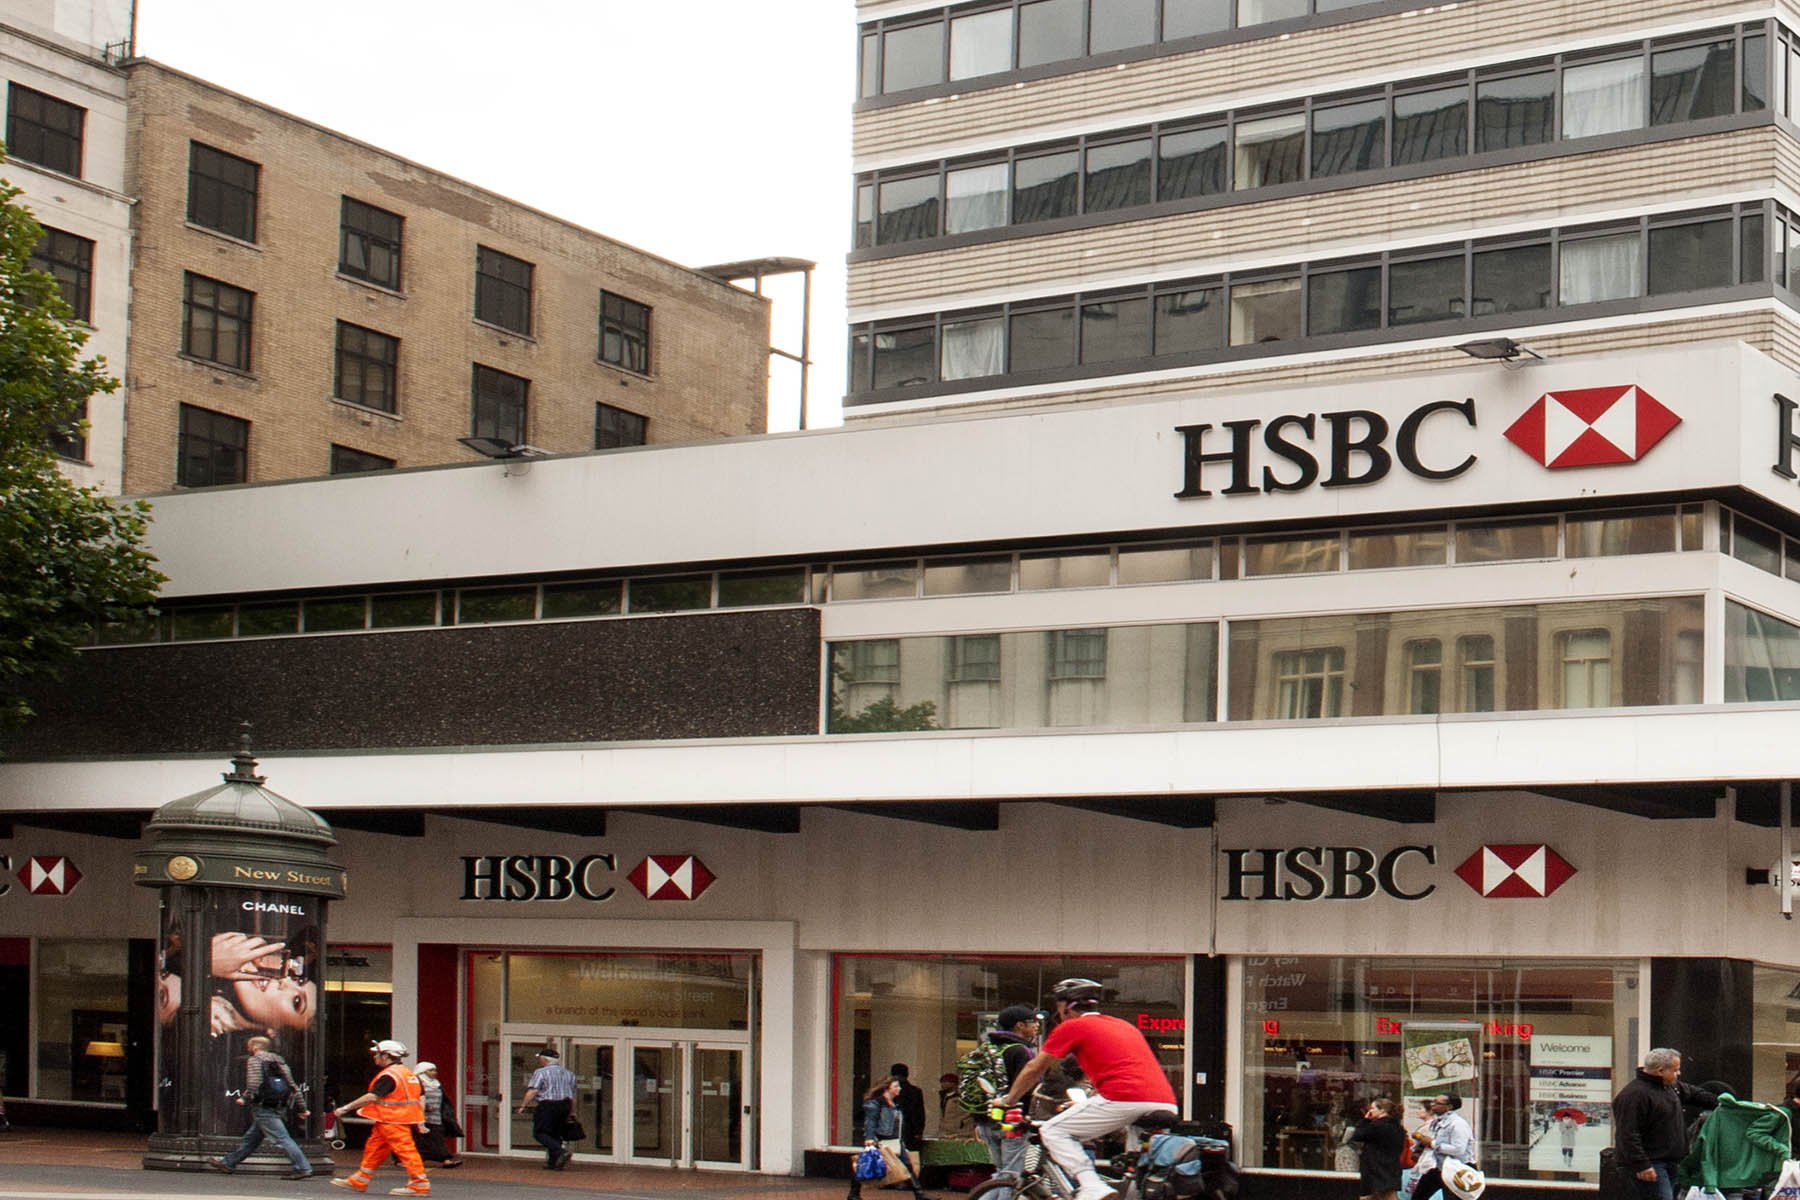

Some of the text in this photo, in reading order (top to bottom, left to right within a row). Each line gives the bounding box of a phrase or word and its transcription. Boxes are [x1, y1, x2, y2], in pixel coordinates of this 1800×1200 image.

[1173, 397, 1477, 499] HSBC
[233, 866, 332, 886] New Street
[460, 855, 617, 902] HSBC
[1221, 845, 1436, 901] HSBC
[242, 901, 305, 915] CHANEL
[1540, 1043, 1591, 1053] Welcome
